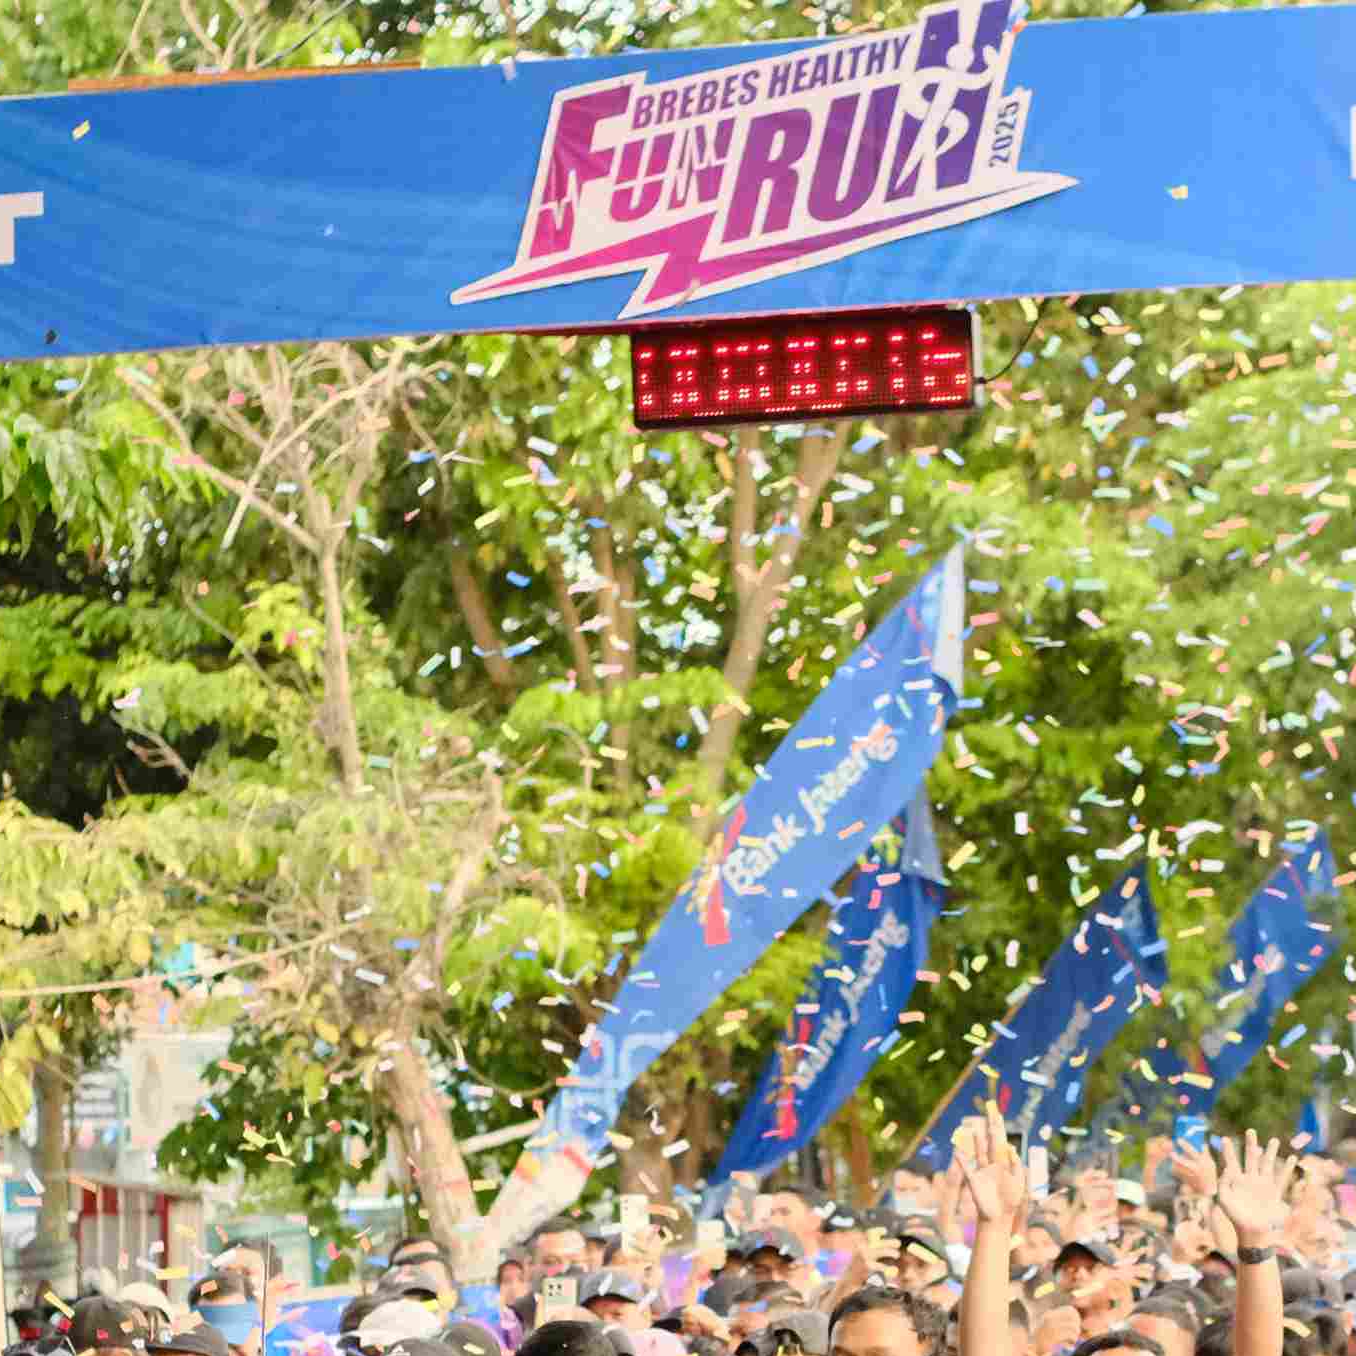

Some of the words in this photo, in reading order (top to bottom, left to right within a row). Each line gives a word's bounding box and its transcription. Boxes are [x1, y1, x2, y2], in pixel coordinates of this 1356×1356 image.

[631, 70, 761, 126] BREBES
[768, 33, 912, 102] HEALTHY
[987, 100, 1021, 168] 2025
